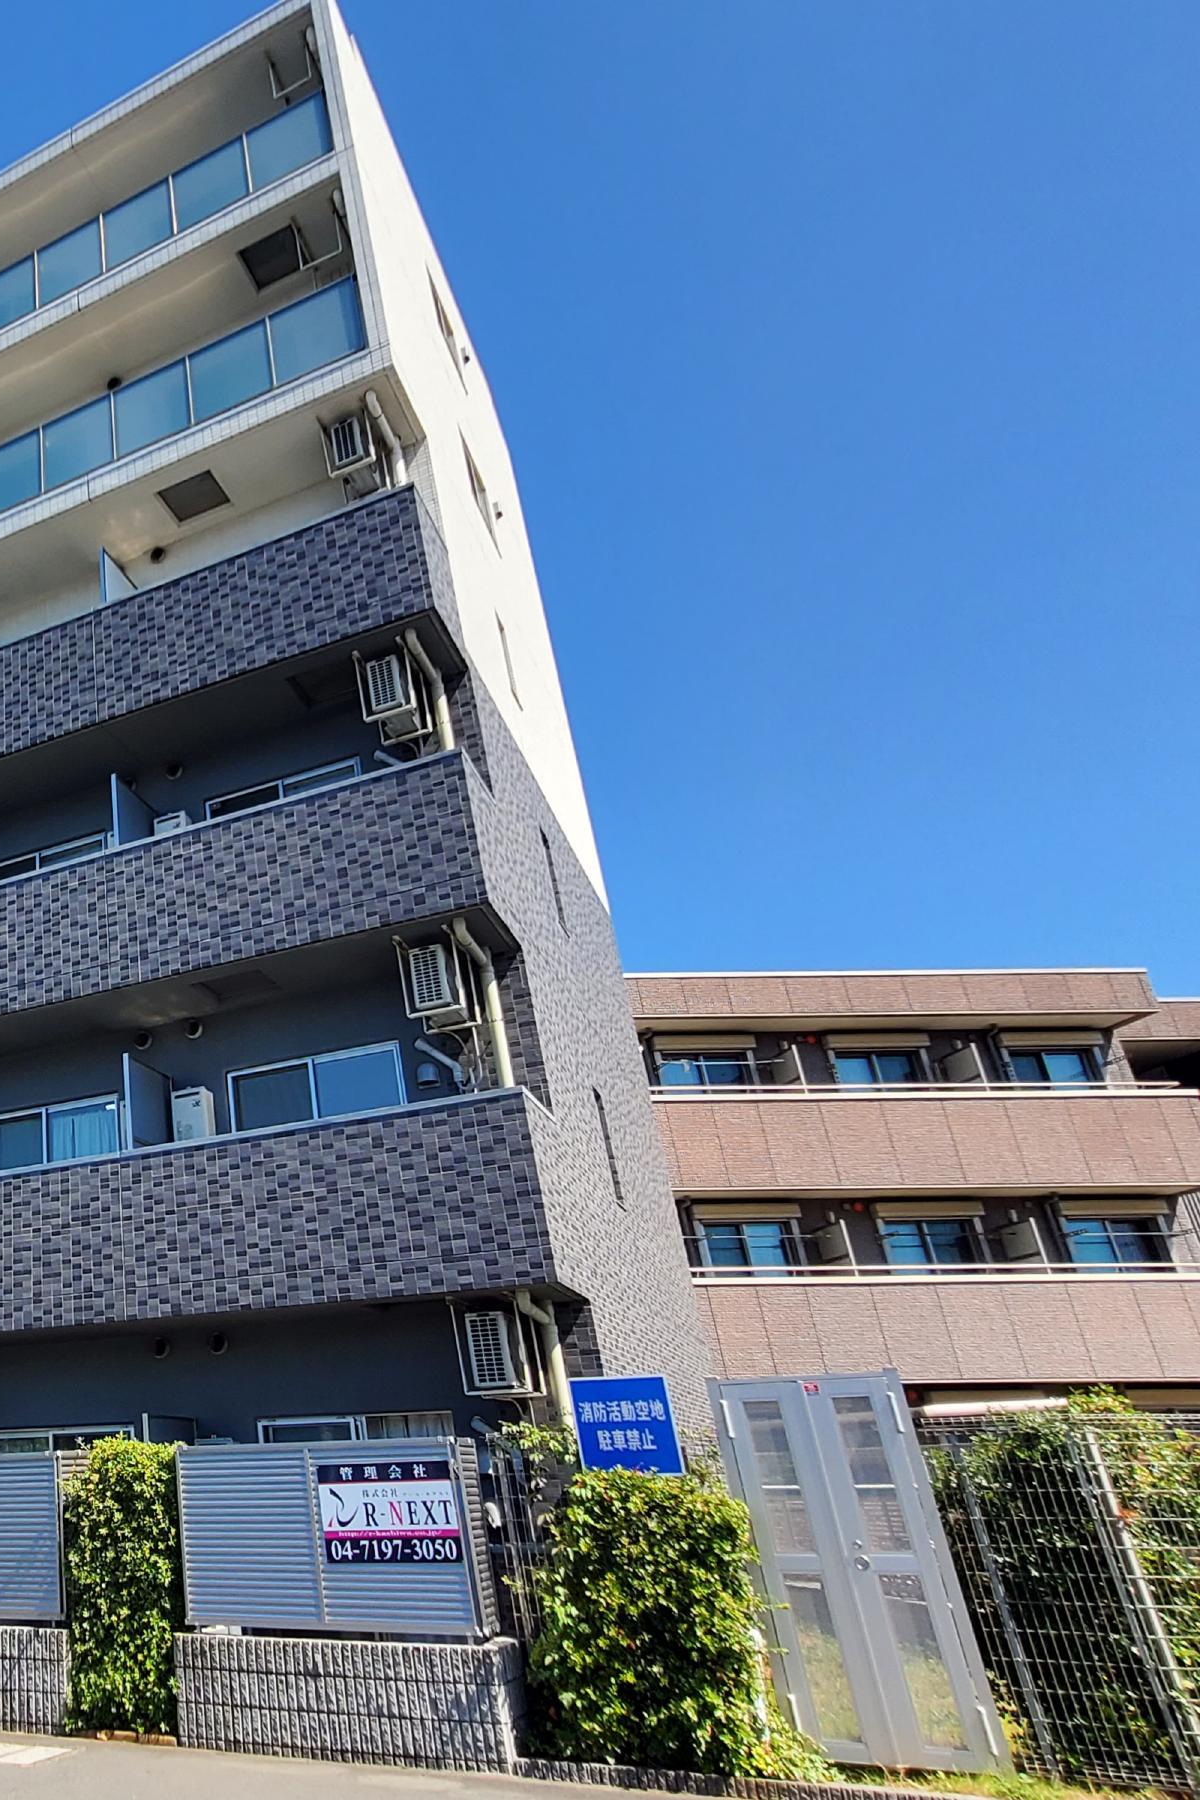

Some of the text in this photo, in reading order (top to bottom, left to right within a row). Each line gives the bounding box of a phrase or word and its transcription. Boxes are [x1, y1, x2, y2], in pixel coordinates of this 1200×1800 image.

[578, 1399, 666, 1423] 消防活動空地
[596, 1428, 658, 1452] 駐車禁止
[339, 1464, 427, 1480] 管理会社
[362, 1488, 398, 1498] 株式会社
[363, 1500, 453, 1527] R-NEXT
[331, 1540, 457, 1560] 04-7197-3050
